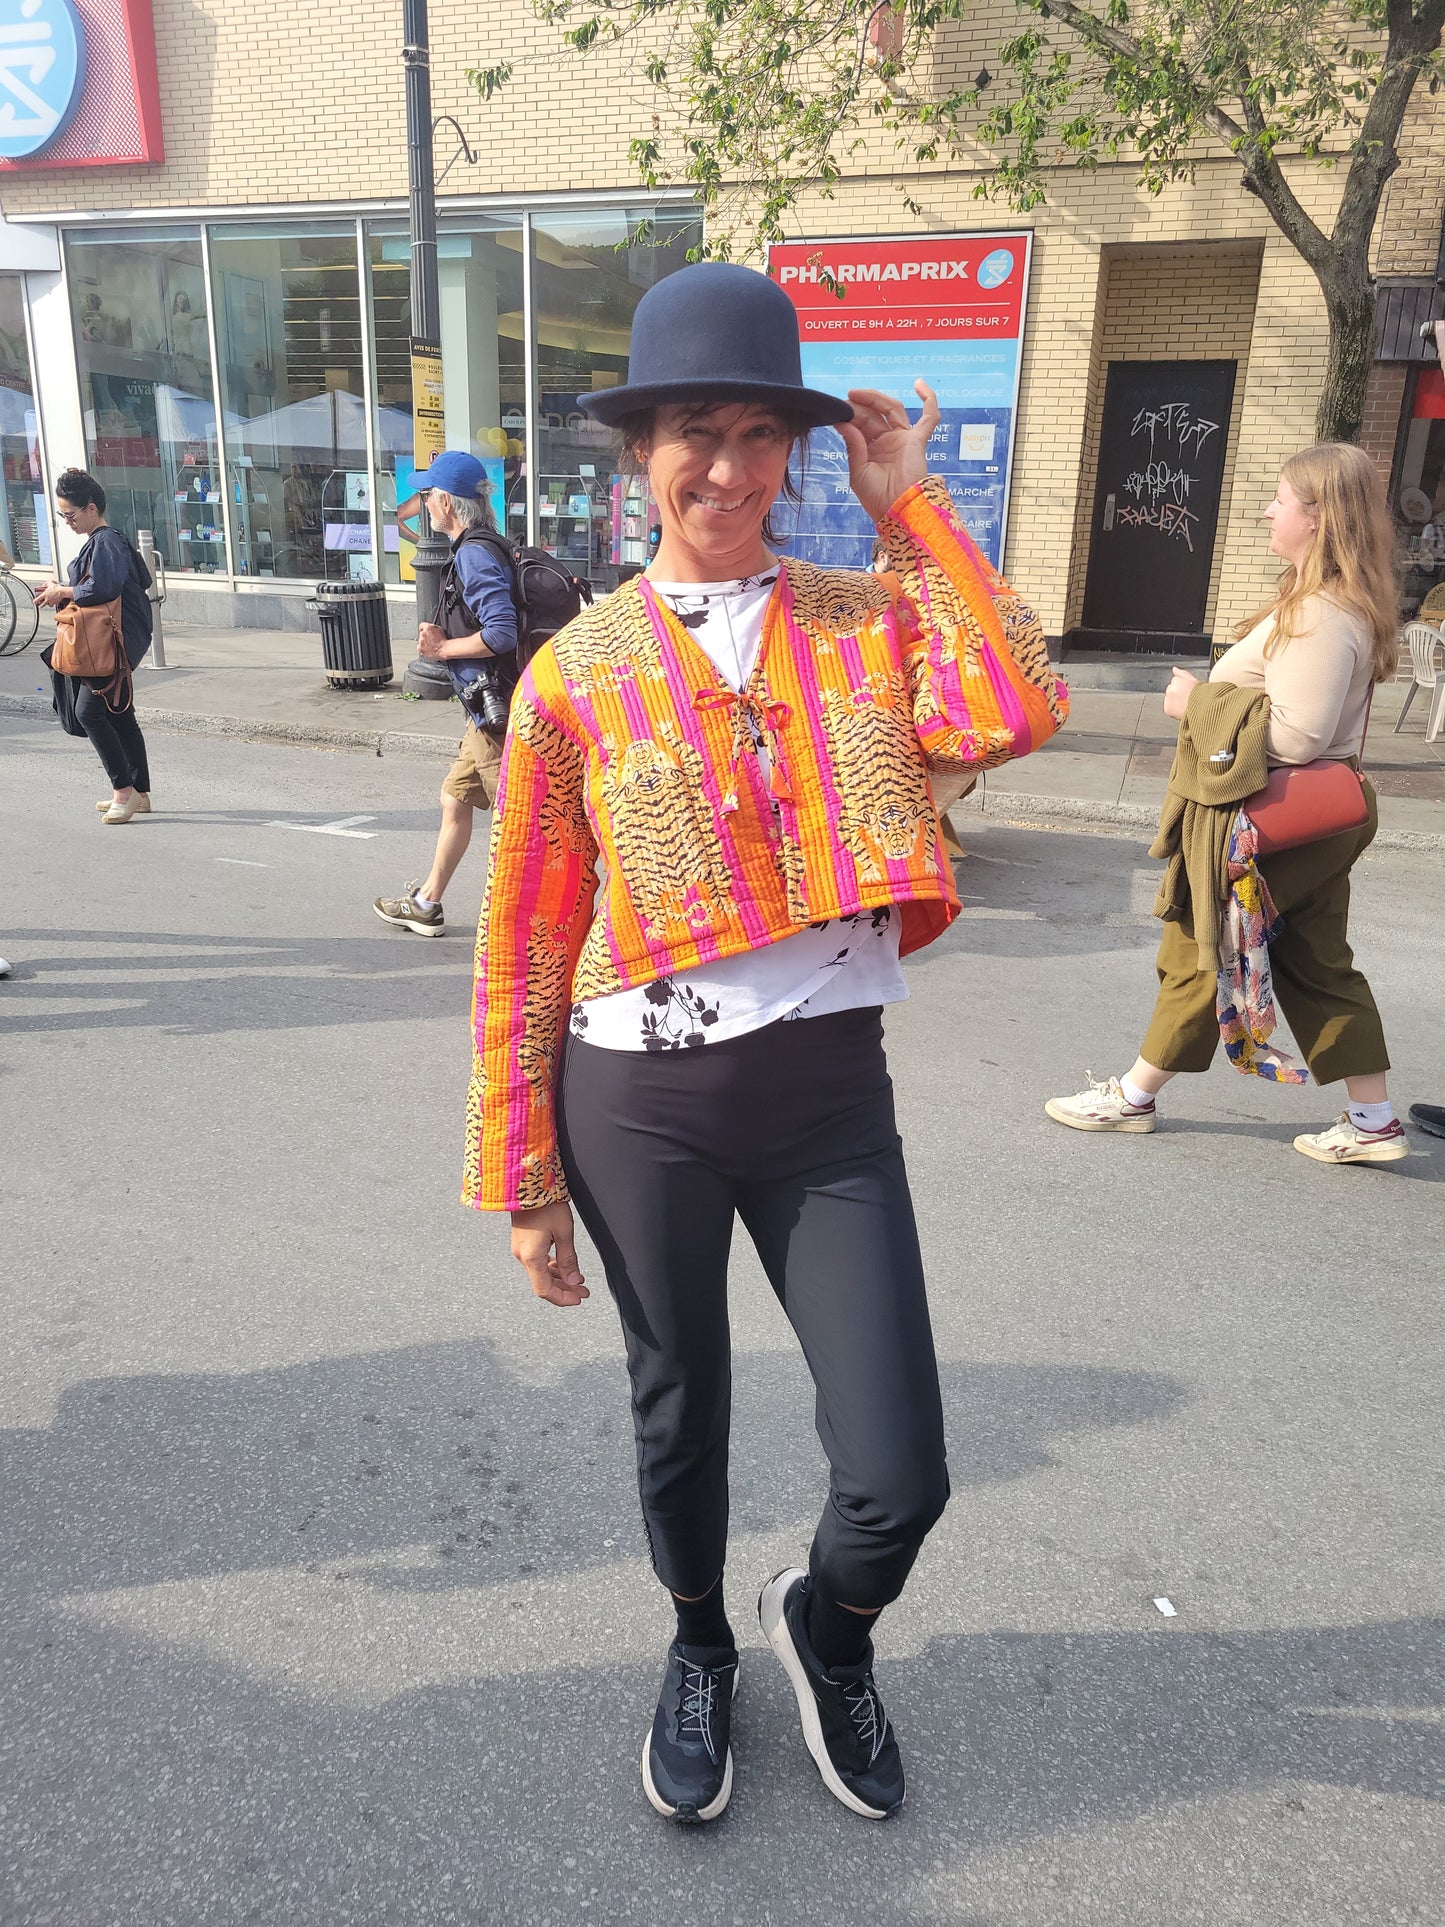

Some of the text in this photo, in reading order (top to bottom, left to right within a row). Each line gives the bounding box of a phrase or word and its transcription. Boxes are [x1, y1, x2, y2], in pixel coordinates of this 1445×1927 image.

[780, 261, 969, 284] PHARMAPRIX
[805, 320, 849, 330] OUVERT
[852, 320, 866, 329] DE
[869, 319, 883, 329] 9H
[886, 316, 894, 328] À
[896, 318, 917, 328] 22H
[926, 318, 933, 327] 7
[935, 317, 973, 327] JOURS
[975, 316, 999, 326] SUR
[1002, 316, 1009, 326] 7
[913, 355, 927, 364] ET
[930, 353, 1006, 364] FRAGRANCES
